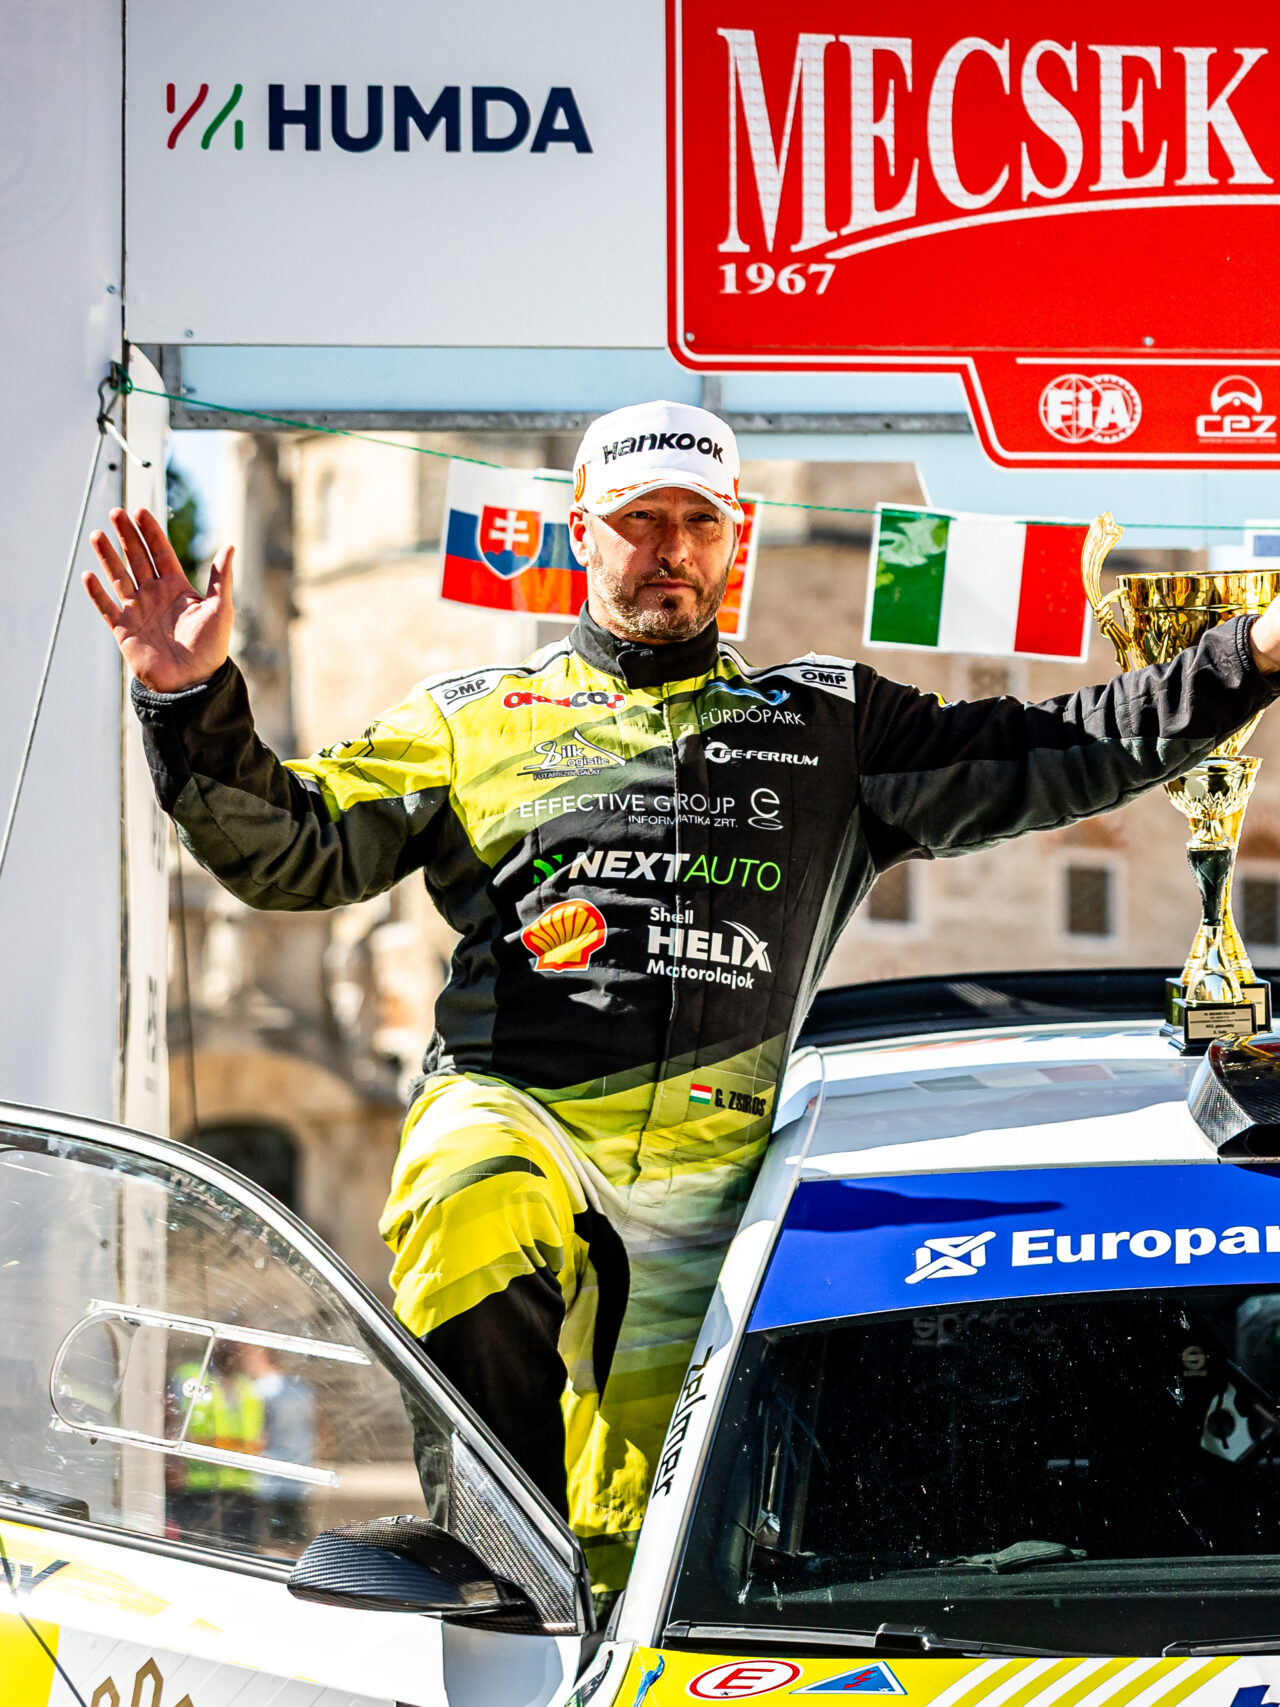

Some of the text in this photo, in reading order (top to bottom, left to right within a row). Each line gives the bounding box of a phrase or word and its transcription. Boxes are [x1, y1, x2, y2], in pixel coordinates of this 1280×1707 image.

[268, 84, 594, 153] HUMDA
[716, 28, 1275, 253] MECSEK
[718, 262, 836, 295] 1967
[444, 679, 487, 700] OMP
[801, 671, 847, 685] OMP
[519, 793, 735, 818] EFFECTIVE GROUP
[628, 814, 739, 828] INFORMATIKA ZRT.
[650, 907, 694, 925] Shell
[647, 921, 773, 974] HELIX
[646, 959, 755, 989] Motorolajok
[715, 1088, 726, 1109] G.
[713, 1667, 777, 1690] E
